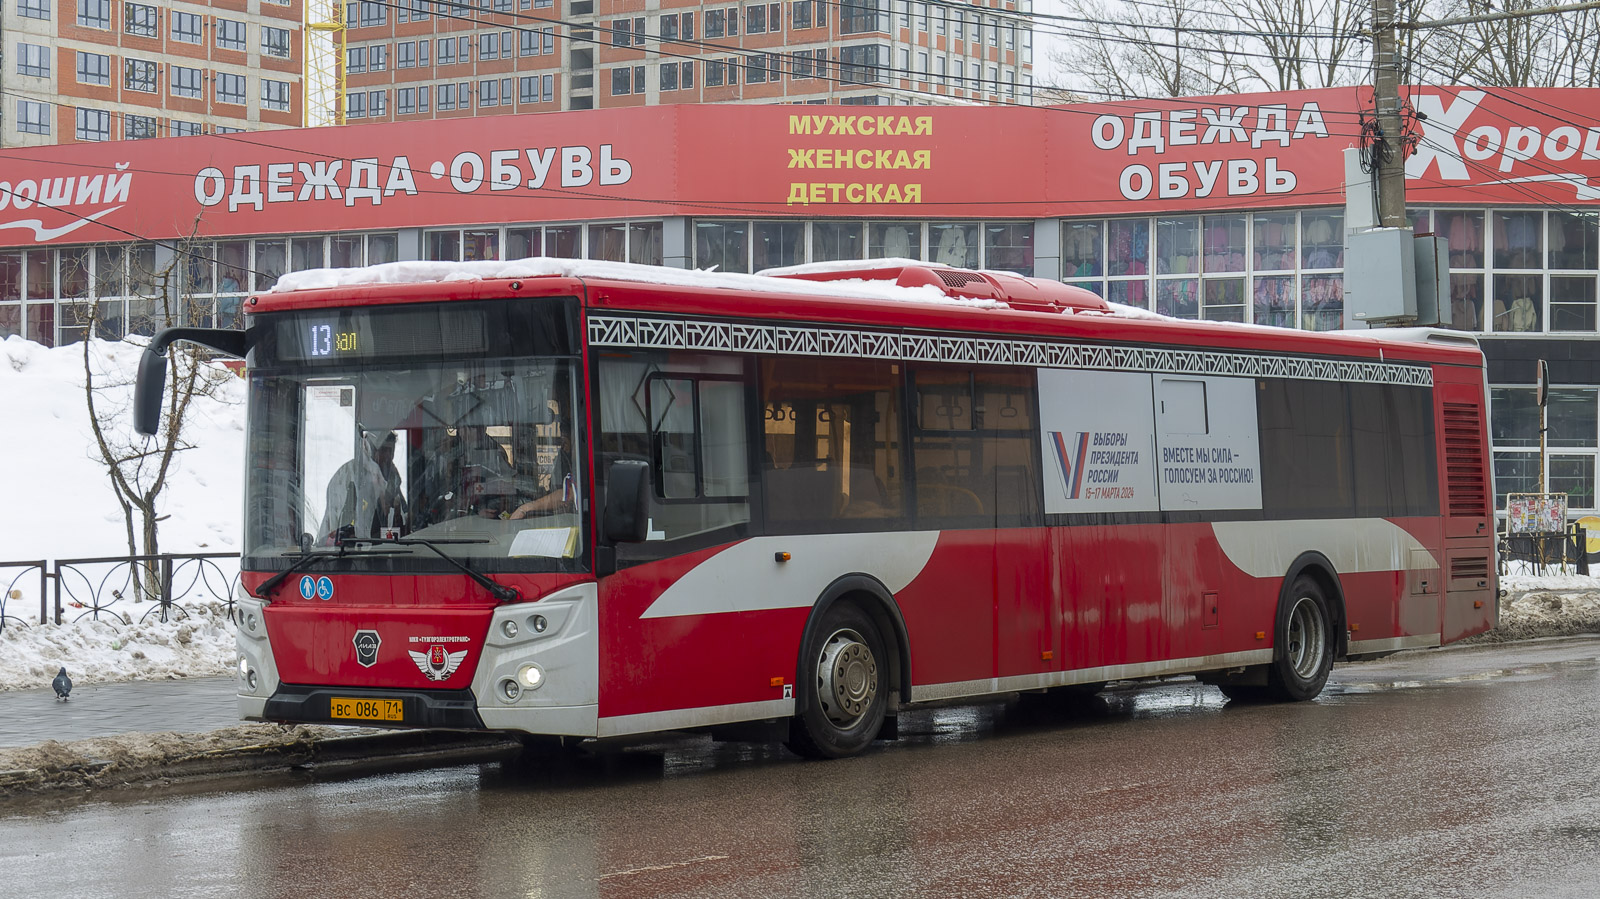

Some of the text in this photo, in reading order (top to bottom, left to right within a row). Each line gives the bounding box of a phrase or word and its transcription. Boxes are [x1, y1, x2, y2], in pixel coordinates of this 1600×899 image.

[789, 115, 933, 136] МУЖСКАЯ
[1091, 101, 1330, 156] ОДЕЖДА
[787, 148, 931, 169] ЖЕНСКАЯ
[194, 143, 633, 212] ОДЕЖДА ОБУВЬ
[1119, 157, 1298, 201] ОБУВЬ
[787, 182, 922, 206] ДЕТСКАЯ
[312, 325, 330, 355] 13
[1093, 432, 1128, 446] ВЫБОРЫ
[1090, 451, 1139, 466] ПРЕЗИДЕНТА
[1163, 447, 1194, 463] ВМЕСТЕ
[1196, 447, 1210, 463] МЫ
[1211, 447, 1232, 463] СИЛА
[1087, 469, 1119, 483] РОССИИ
[1164, 467, 1254, 483] ГОЛОСУЕМ ЗА РОССИЮ!
[1101, 487, 1120, 499] МАРТА
[1120, 487, 1134, 499] 2024
[355, 701, 379, 717] 086
[385, 702, 398, 714] 71
